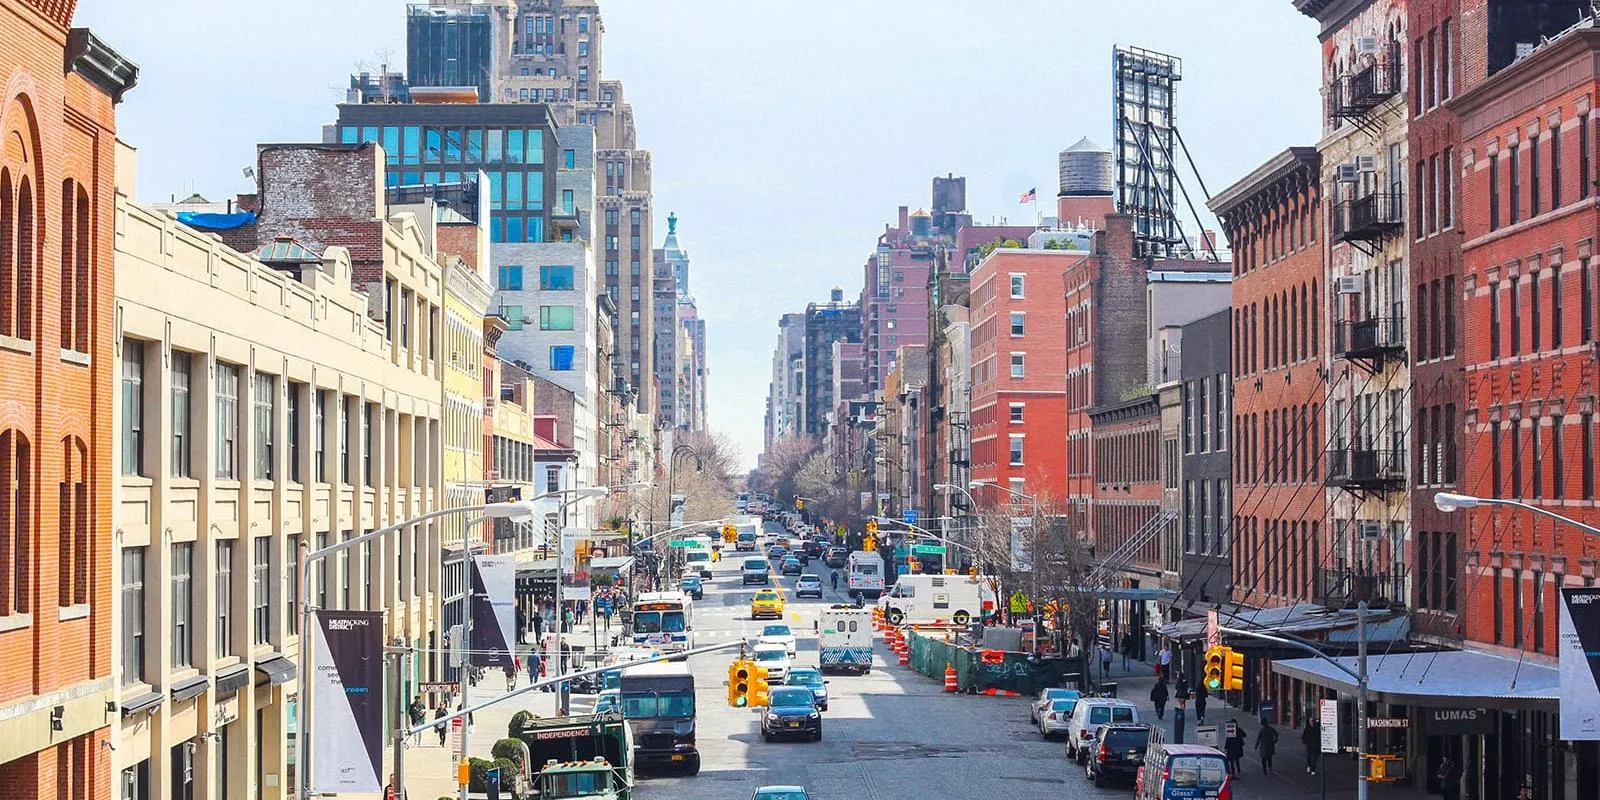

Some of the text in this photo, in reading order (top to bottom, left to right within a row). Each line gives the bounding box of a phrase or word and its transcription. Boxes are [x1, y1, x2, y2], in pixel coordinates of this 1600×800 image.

[1434, 710, 1477, 720] LUMAS
[1370, 719, 1409, 728] WASHINGTON ST
[537, 729, 590, 739] INDEPENDENCE
